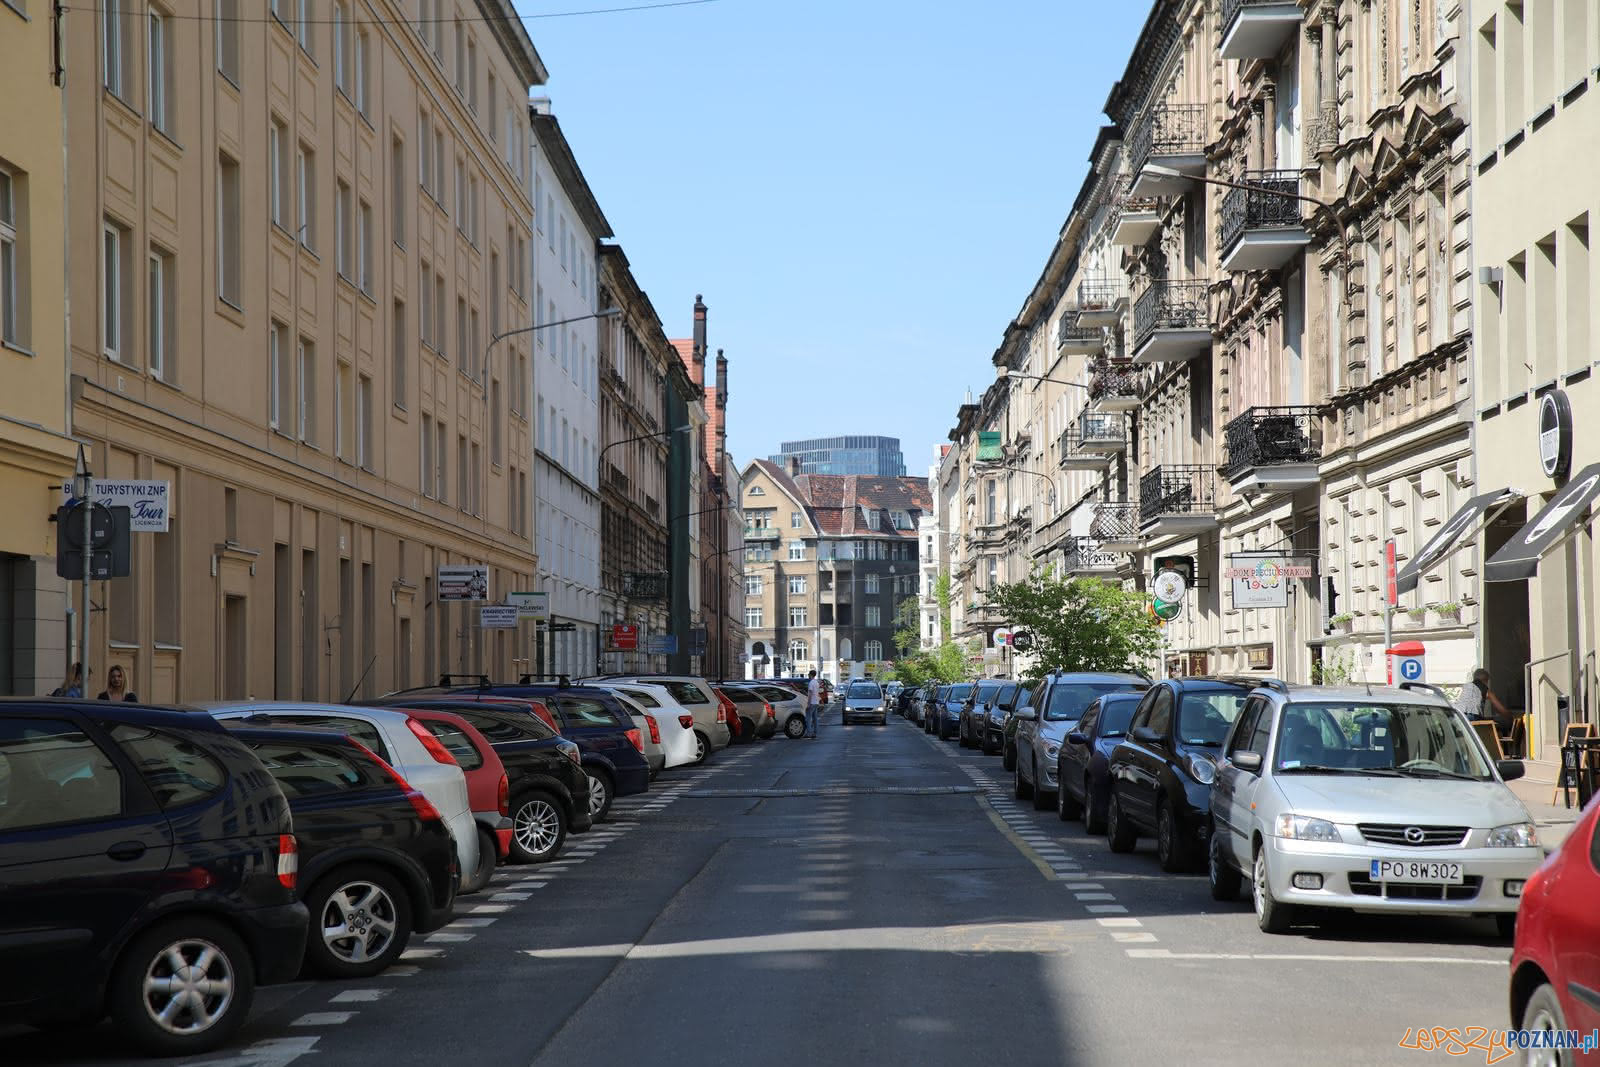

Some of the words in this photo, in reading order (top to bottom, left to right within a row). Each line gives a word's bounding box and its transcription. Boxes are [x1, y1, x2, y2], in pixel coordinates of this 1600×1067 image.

[96, 484, 146, 495] TURYSTYKI
[147, 485, 166, 496] ZNP
[131, 500, 164, 520] Tour
[1233, 569, 1249, 577] DOM
[1406, 662, 1418, 677] P
[1381, 861, 1404, 877] PO
[1409, 862, 1459, 879] 8W302
